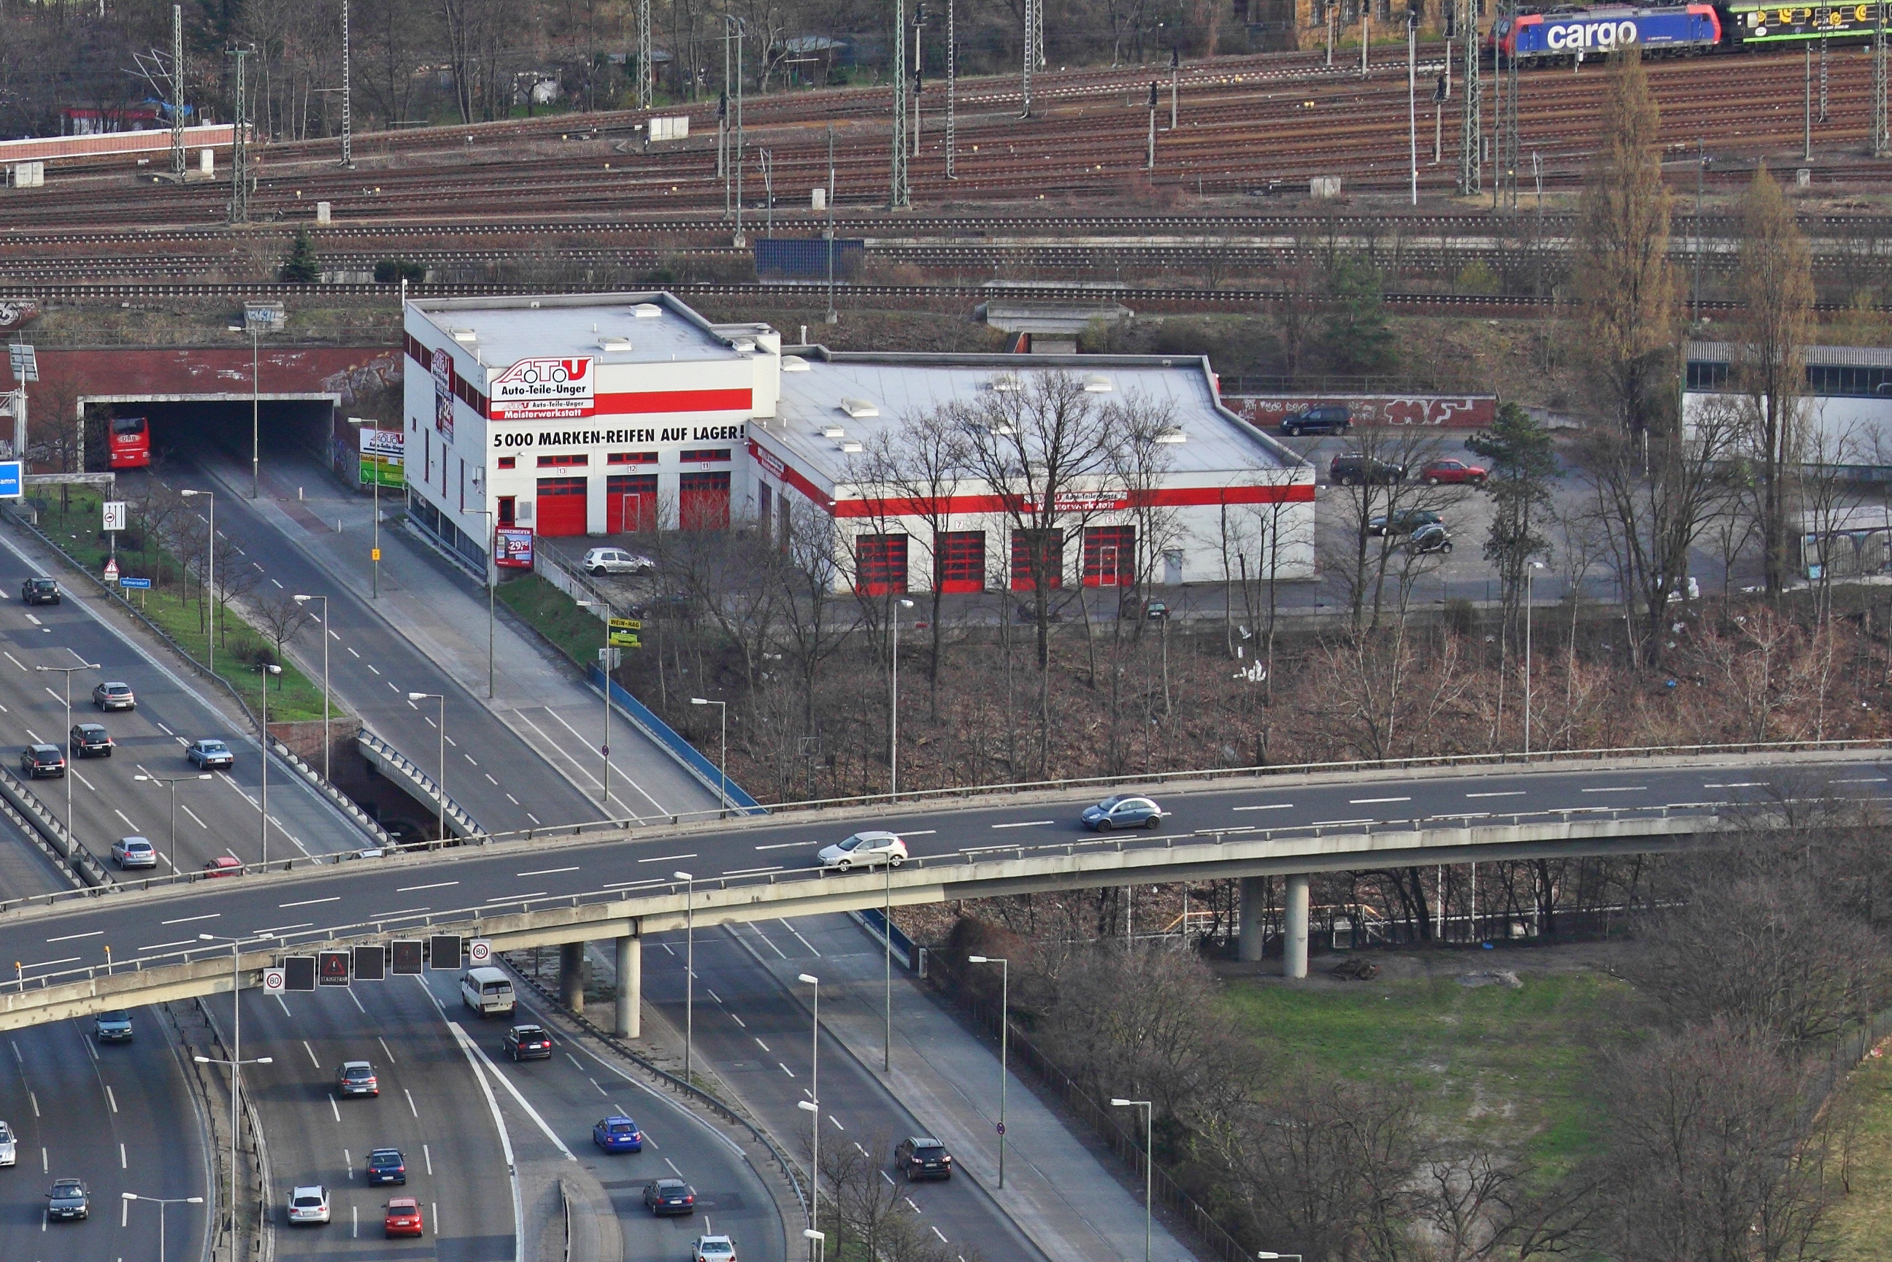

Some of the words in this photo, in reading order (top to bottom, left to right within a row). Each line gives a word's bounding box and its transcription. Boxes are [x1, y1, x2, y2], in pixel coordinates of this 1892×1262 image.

[1547, 20, 1638, 52] cargo
[501, 384, 587, 396] Auto-Teile-Unger
[504, 408, 582, 419] Meisterwerkstatt
[538, 428, 655, 446] MARKEN-REIFEN
[660, 427, 688, 442] AUF
[693, 424, 746, 441] LAGER!
[475, 948, 486, 956] 80
[269, 976, 279, 985] 80
